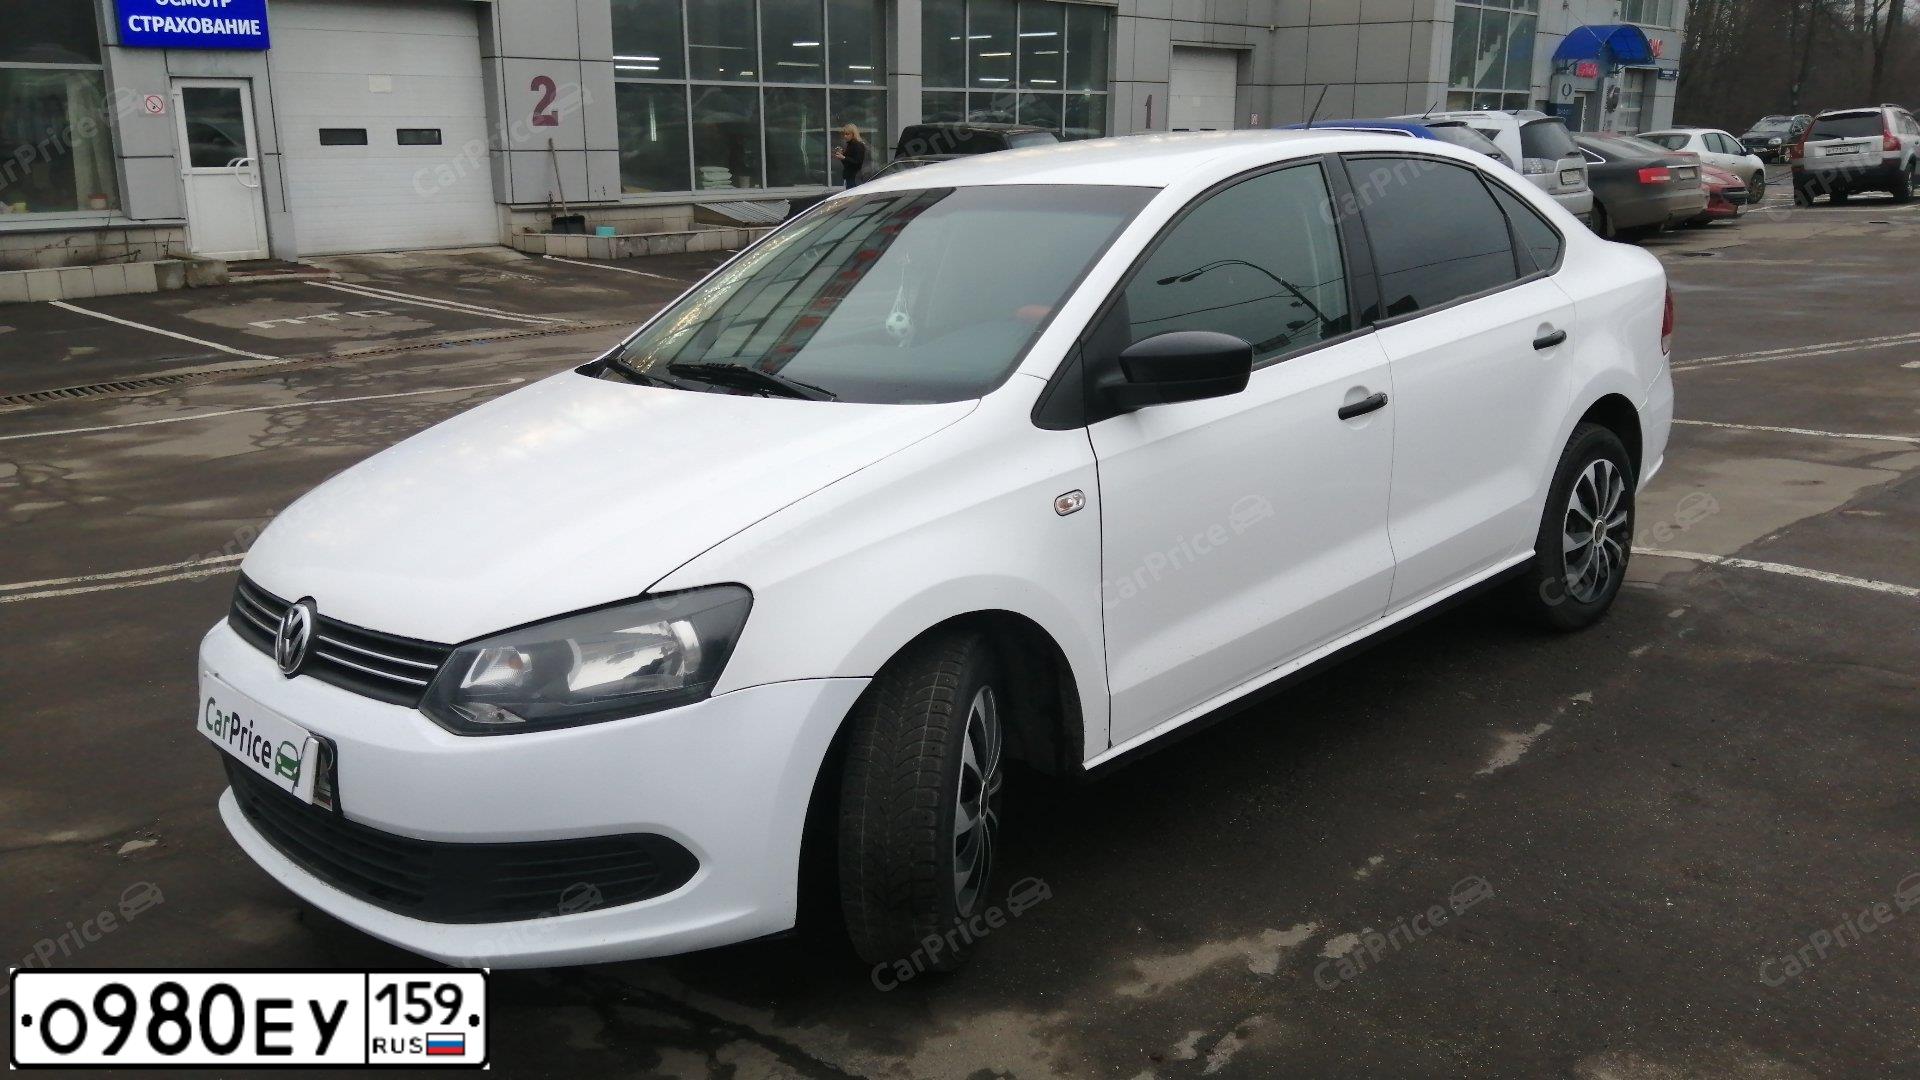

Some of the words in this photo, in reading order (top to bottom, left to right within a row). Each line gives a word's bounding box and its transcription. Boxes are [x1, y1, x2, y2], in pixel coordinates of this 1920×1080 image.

[128, 15, 261, 36] СТРАХОВАНИЕ
[530, 75, 559, 127] 2
[205, 696, 272, 769] CarPrice
